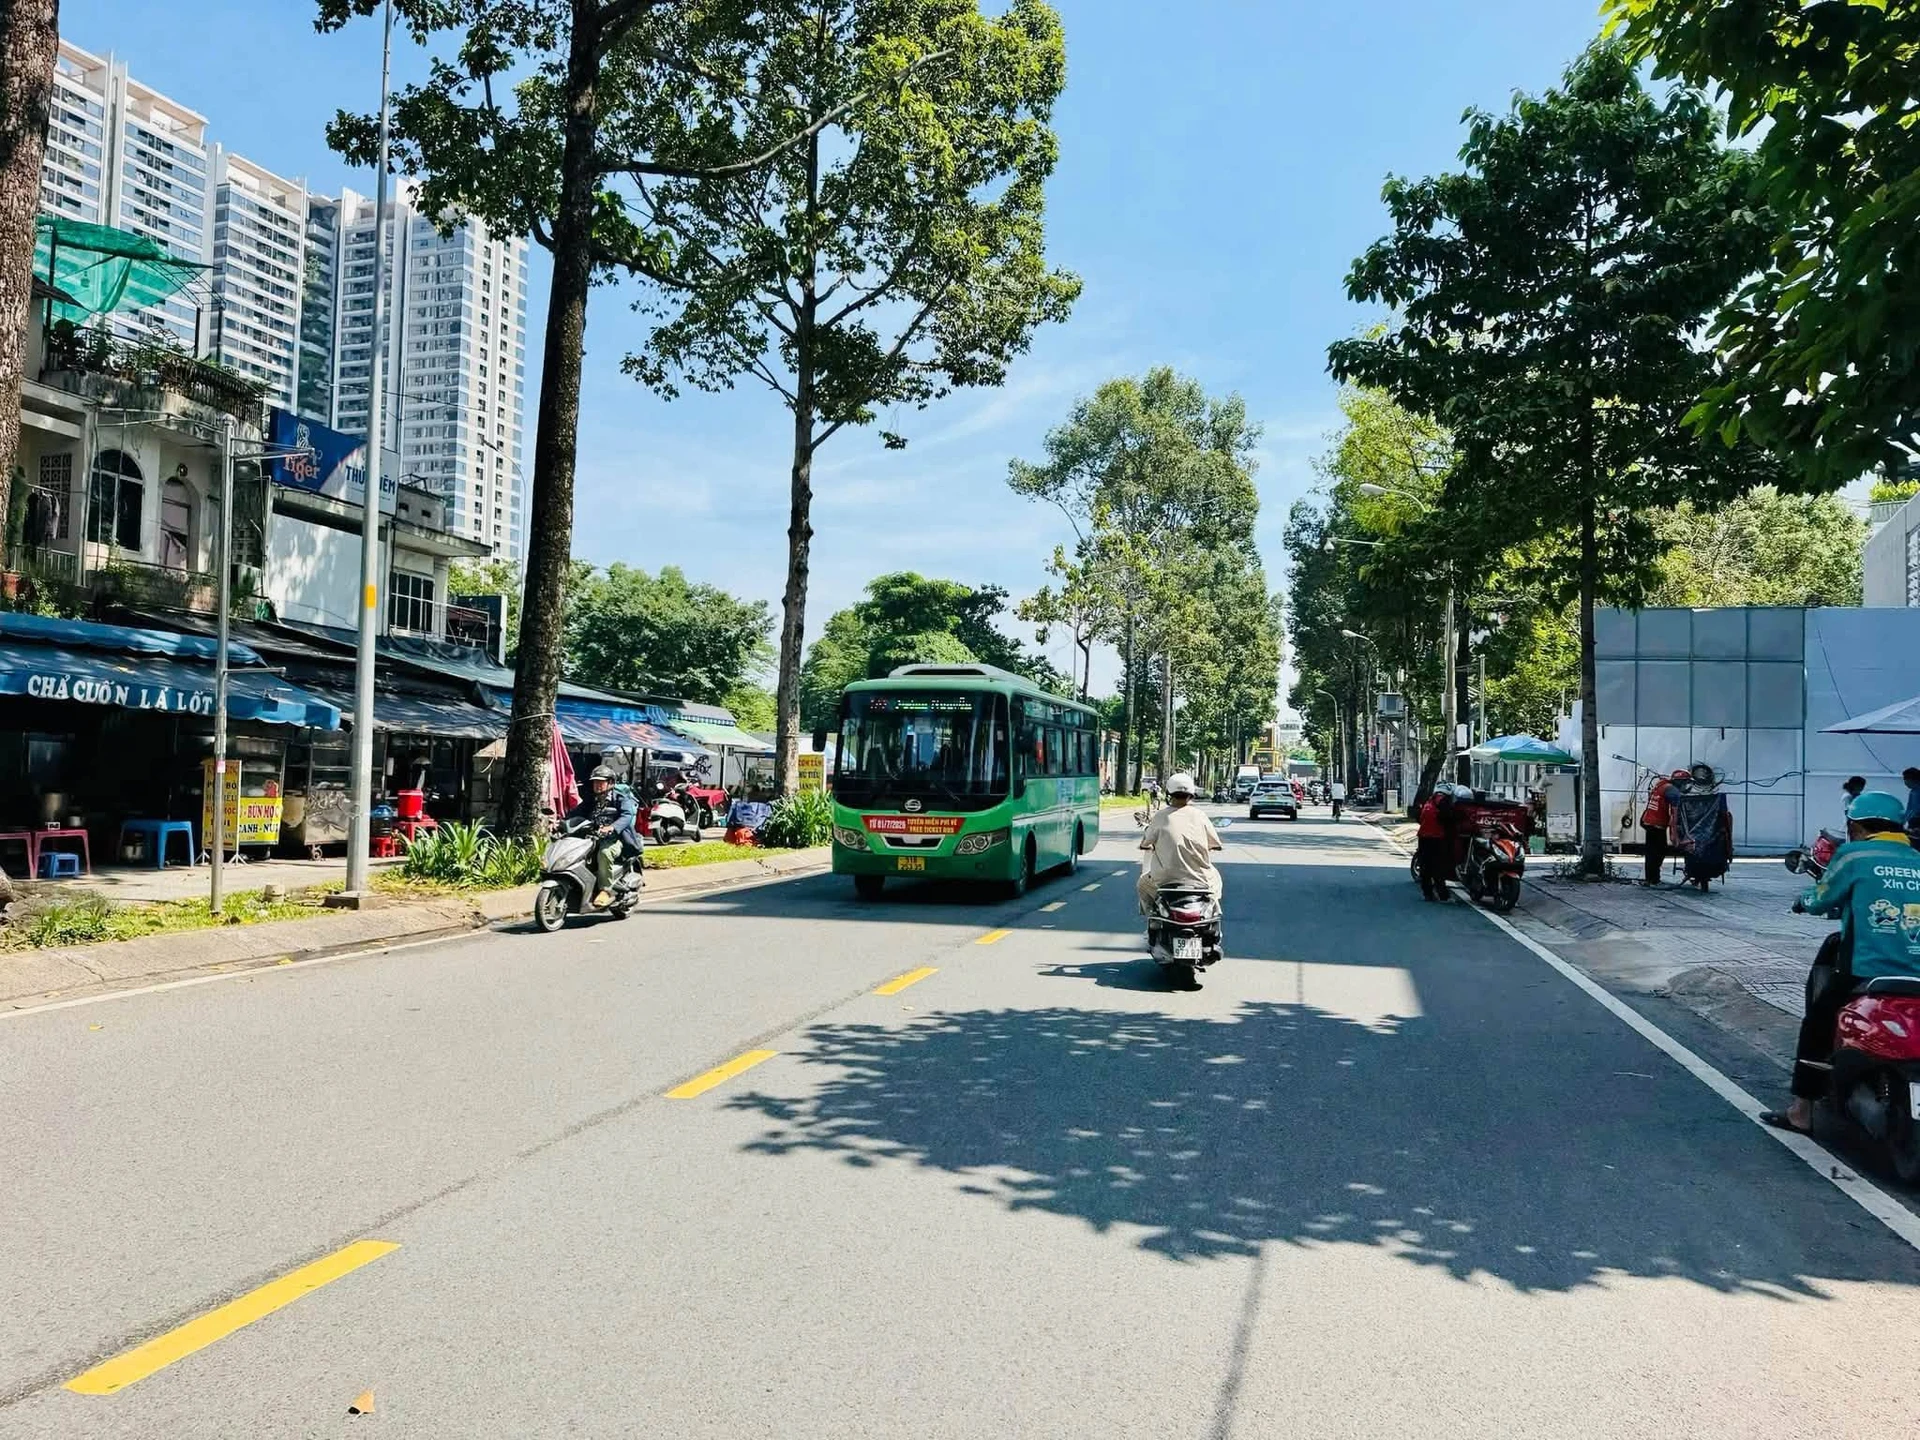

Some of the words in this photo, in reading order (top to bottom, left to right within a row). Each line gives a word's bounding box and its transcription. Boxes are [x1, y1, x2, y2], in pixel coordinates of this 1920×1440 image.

[283, 455, 321, 482] Tiger
[27, 674, 70, 699] CHẢ
[73, 680, 130, 706] CUỐN
[1873, 865, 1920, 879] GREEN
[1882, 878, 1904, 890] Xin
